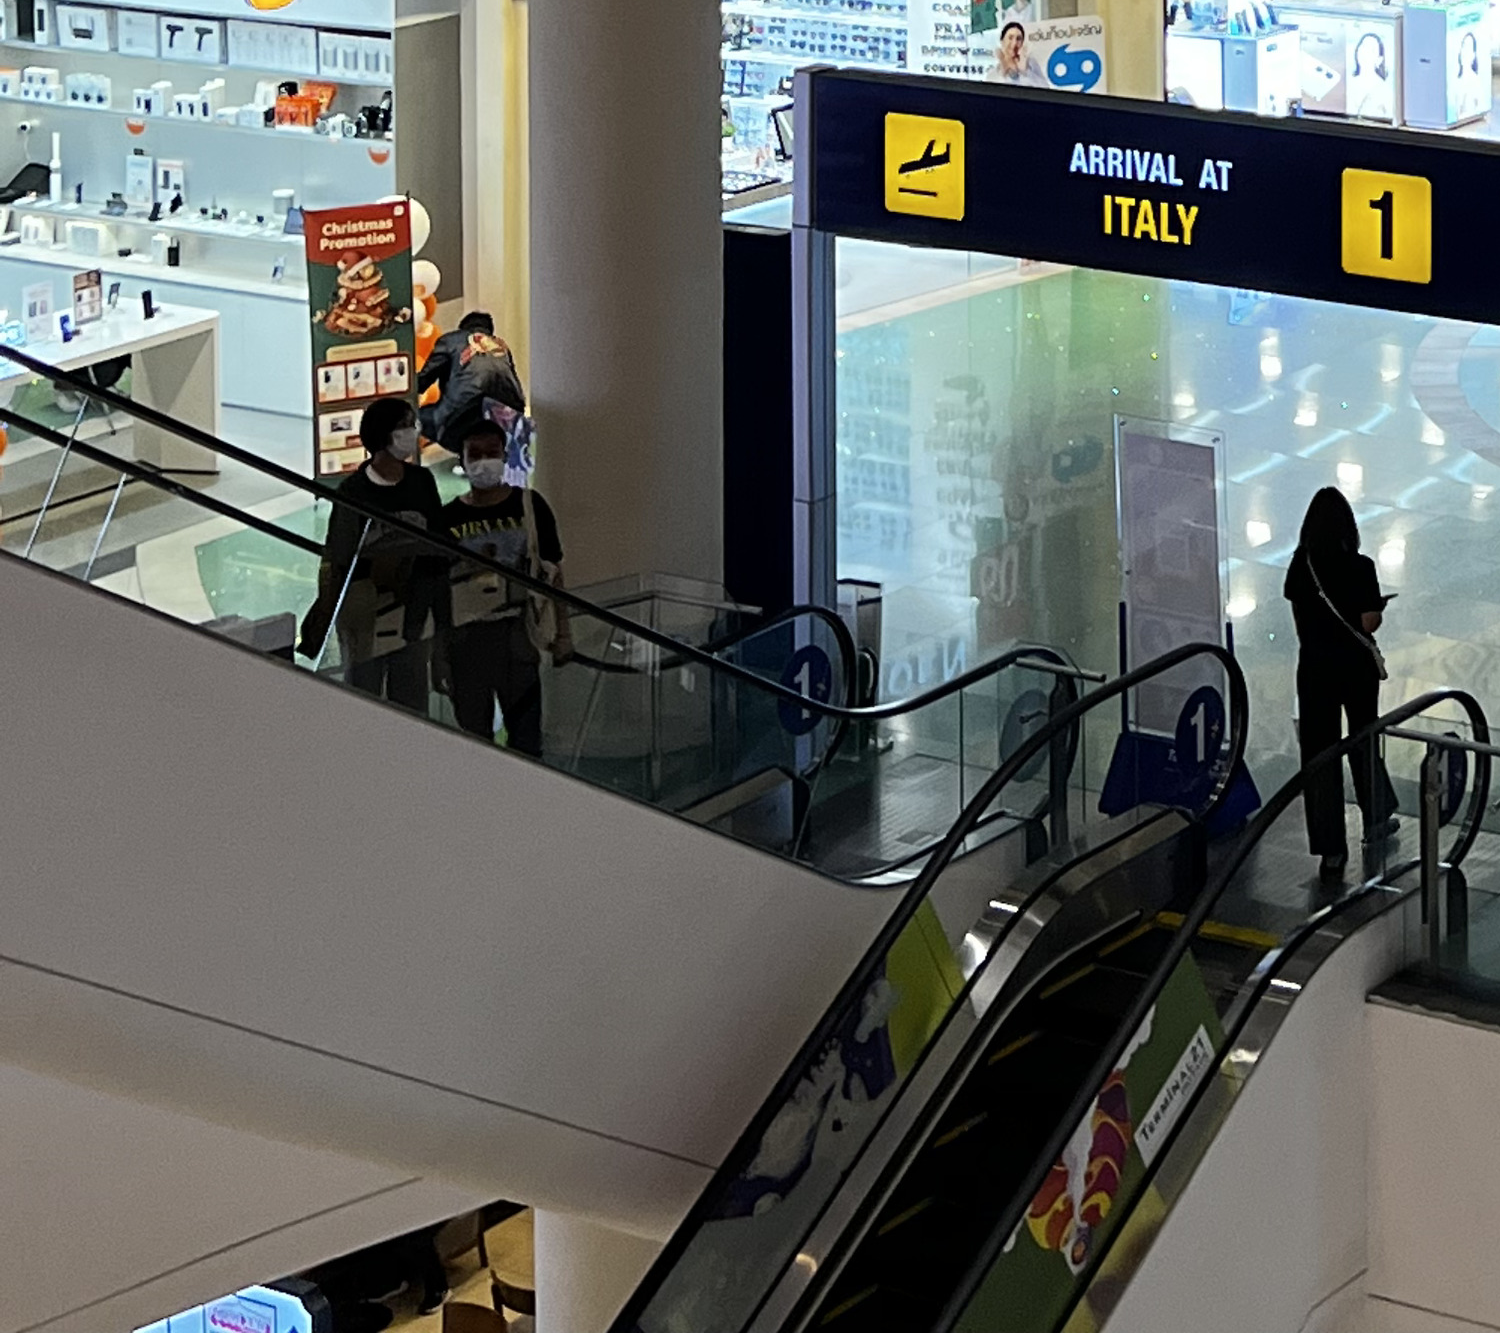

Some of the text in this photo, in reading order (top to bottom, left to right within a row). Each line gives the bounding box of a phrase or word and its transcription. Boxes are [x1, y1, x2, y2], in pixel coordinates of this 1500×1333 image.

[1069, 142, 1234, 192] ARRIVAL AT
[319, 232, 396, 252] Promotion
[321, 218, 394, 237] Christmas
[1103, 194, 1199, 246] ITALY
[1369, 190, 1394, 261] 1
[793, 660, 811, 720] 1
[1189, 701, 1206, 763] 1
